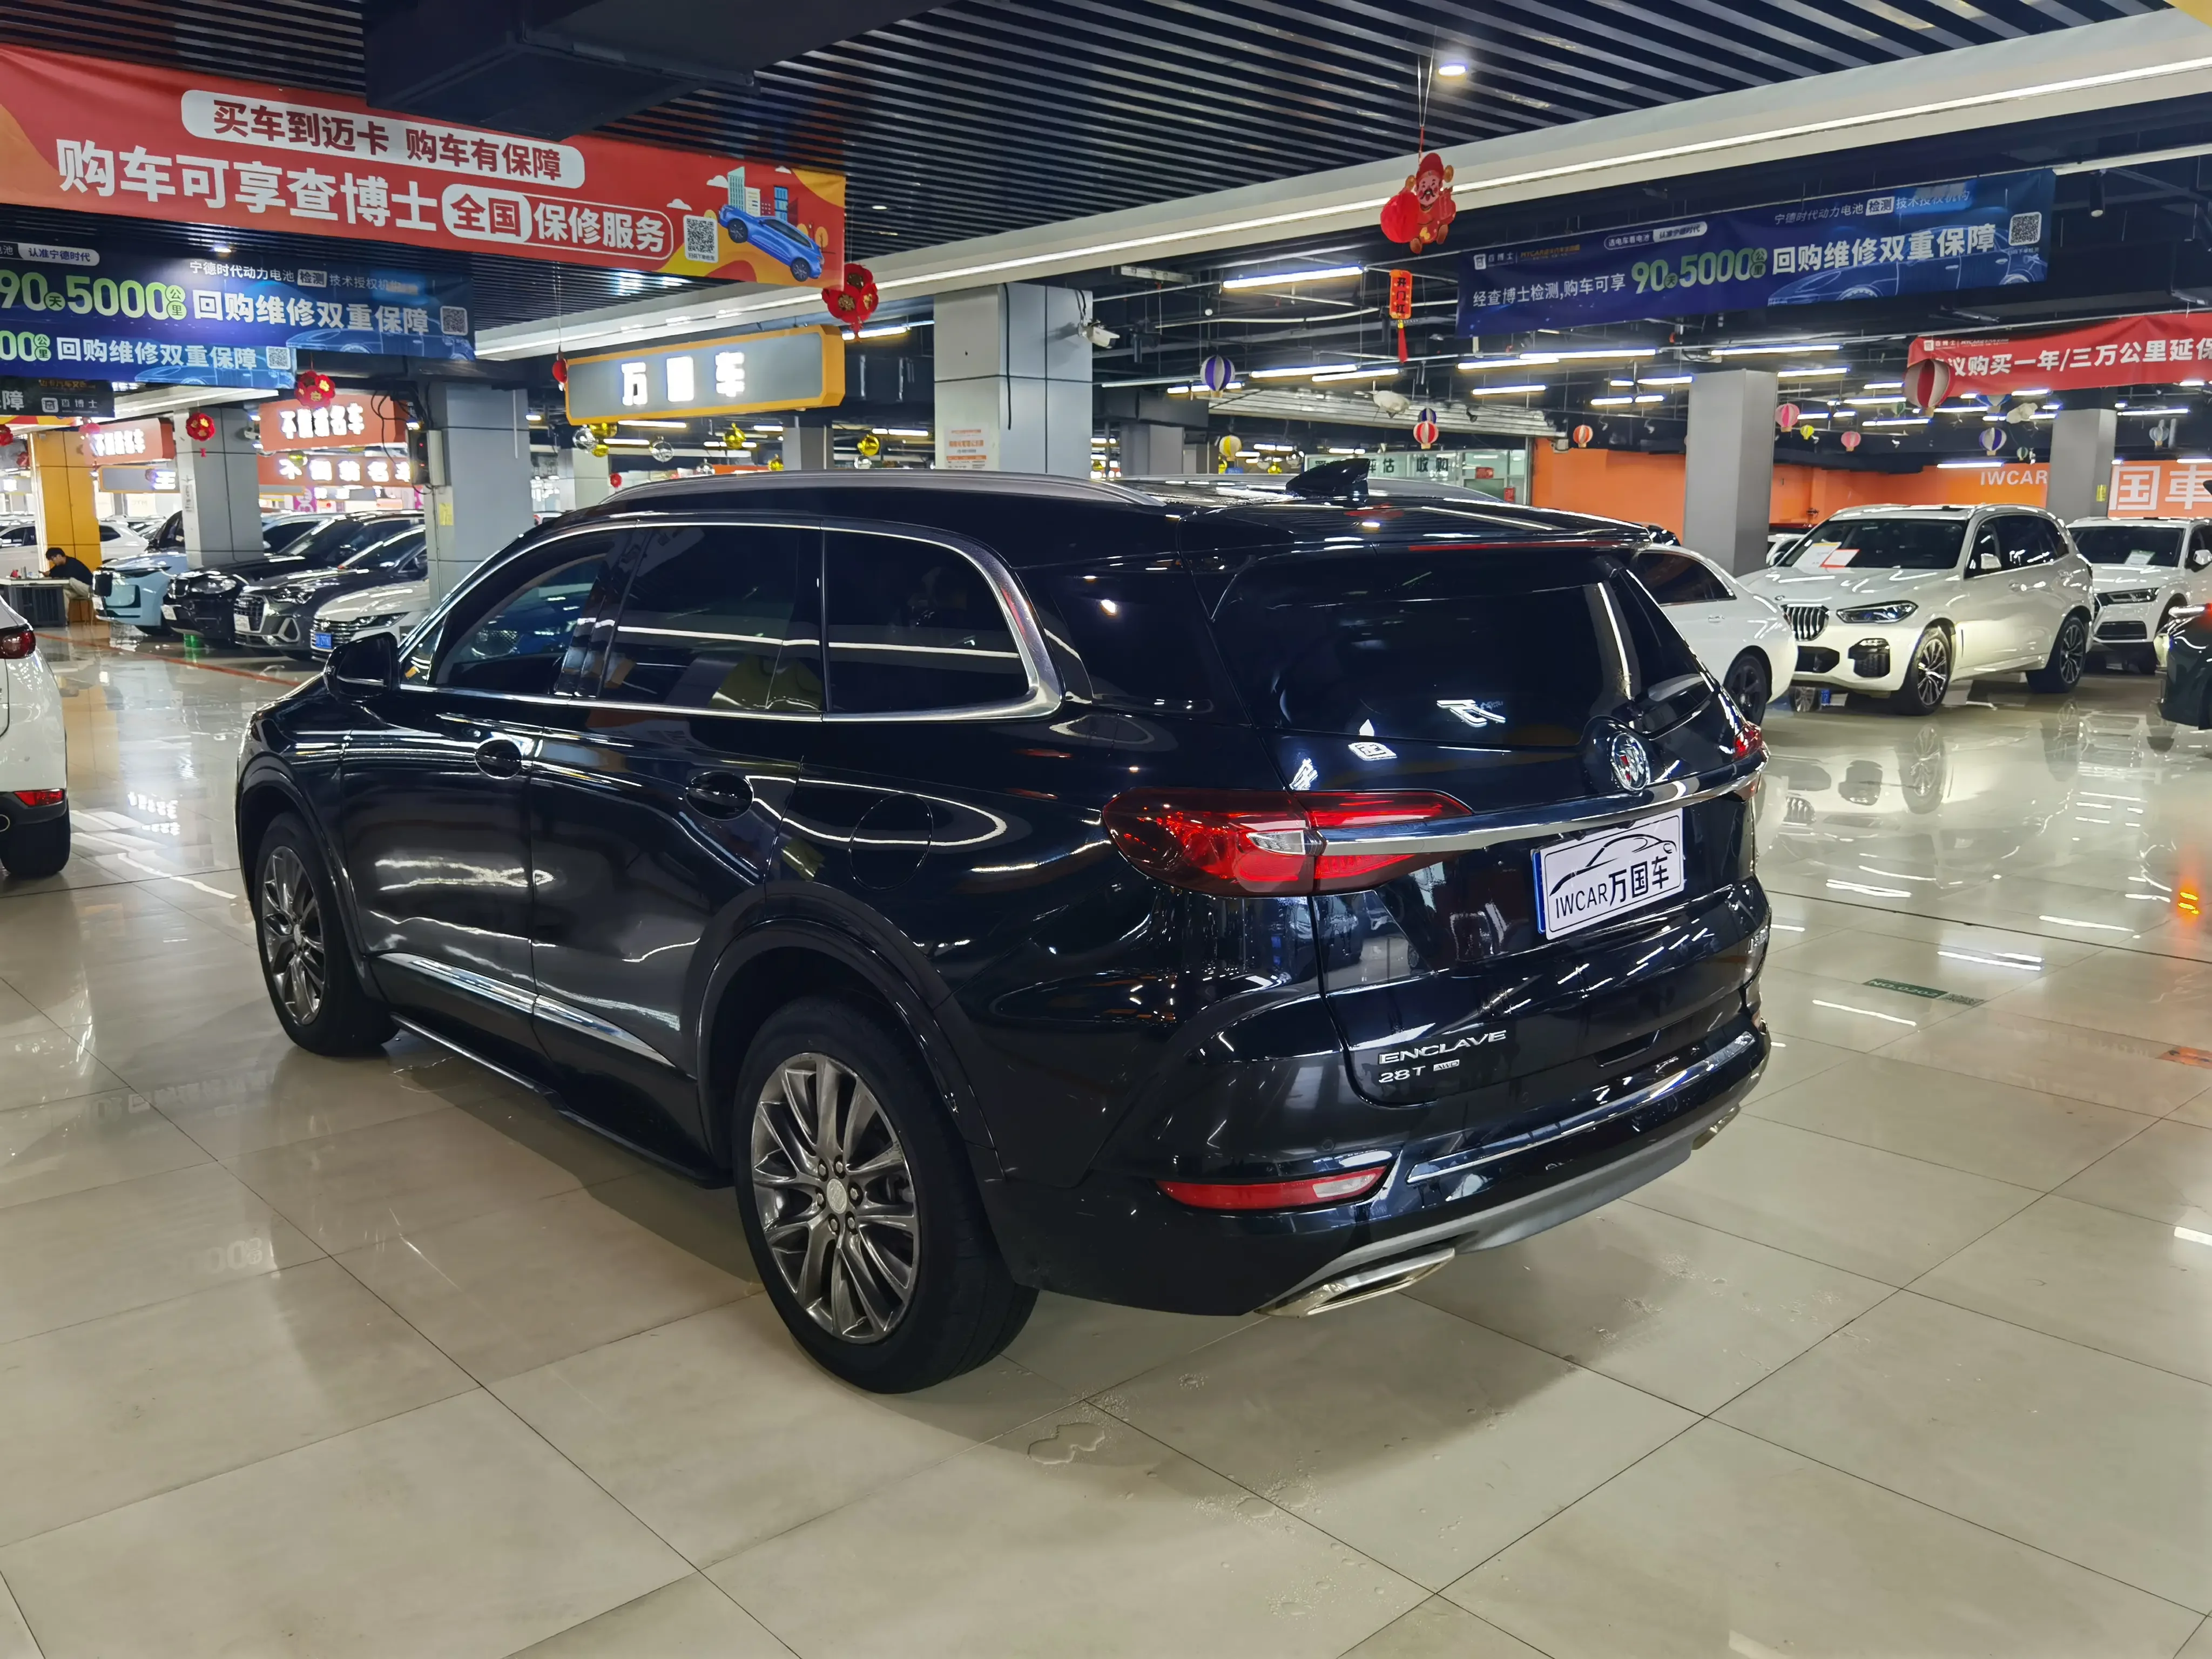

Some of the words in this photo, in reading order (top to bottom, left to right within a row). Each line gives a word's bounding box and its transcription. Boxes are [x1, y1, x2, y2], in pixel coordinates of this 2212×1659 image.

[213, 99, 389, 155] 买车到迈卡
[406, 127, 562, 181] 购车有保障
[56, 138, 437, 232] 购车可享查博士
[450, 193, 523, 238] 全国
[534, 202, 665, 253] 保修服务
[29, 247, 91, 262] 认准宁德时代
[1772, 223, 1996, 275] 回购维修双重保障
[193, 289, 430, 335] 回购维修双重保障
[57, 337, 257, 369] 回购维修双重保障
[1936, 336, 2212, 377] 议购买一年/三万公里延保
[0, 390, 24, 410] 障
[1980, 469, 2048, 485] IWCAR
[1379, 1029, 1507, 1064] ENCLAVE
[1379, 1066, 1426, 1083] 28T
[1434, 1060, 1459, 1071] AWD
